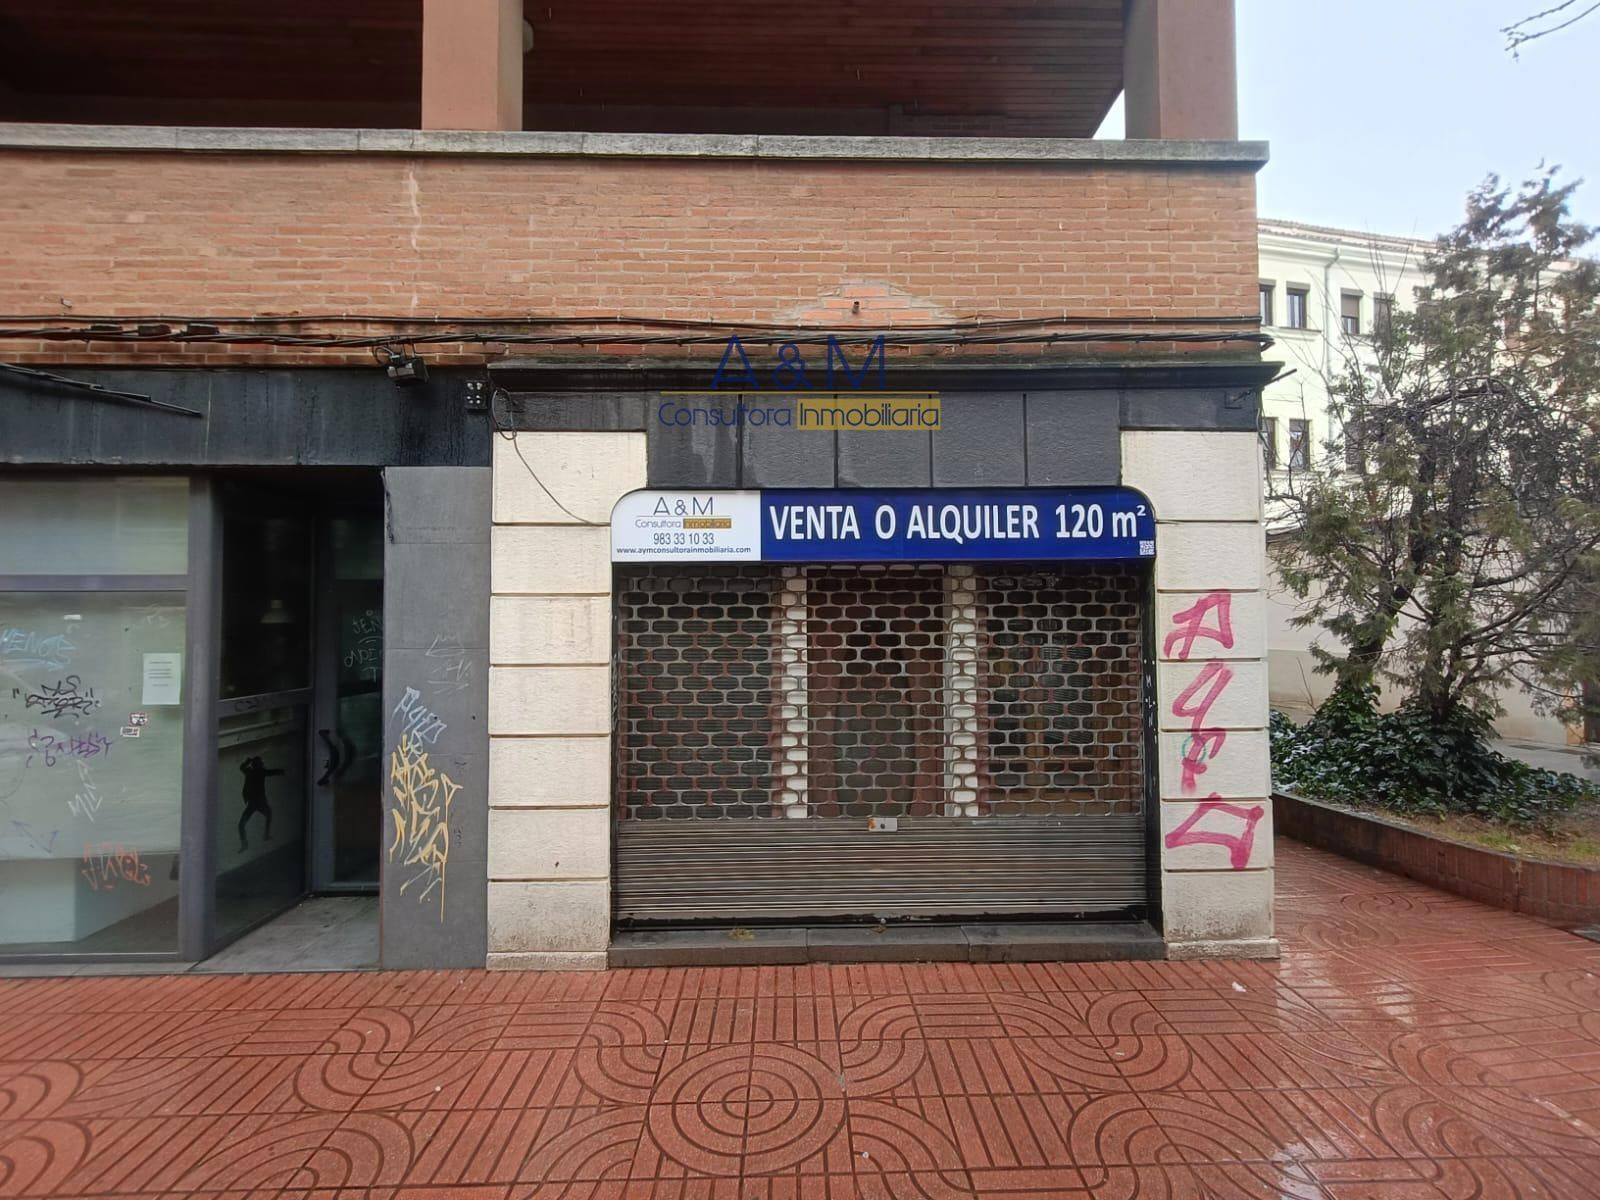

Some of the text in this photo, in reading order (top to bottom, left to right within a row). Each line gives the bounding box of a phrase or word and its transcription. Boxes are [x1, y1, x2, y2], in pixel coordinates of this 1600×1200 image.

[634, 519, 682, 529] Consultora
[769, 505, 861, 540] VENTA
[874, 505, 896, 540] O
[906, 504, 1040, 545] ALQUILER
[1055, 503, 1104, 538] 120
[653, 532, 715, 545] 983 33 10 33
[616, 546, 752, 555] www.aymconsultorainmobiliaria.com
